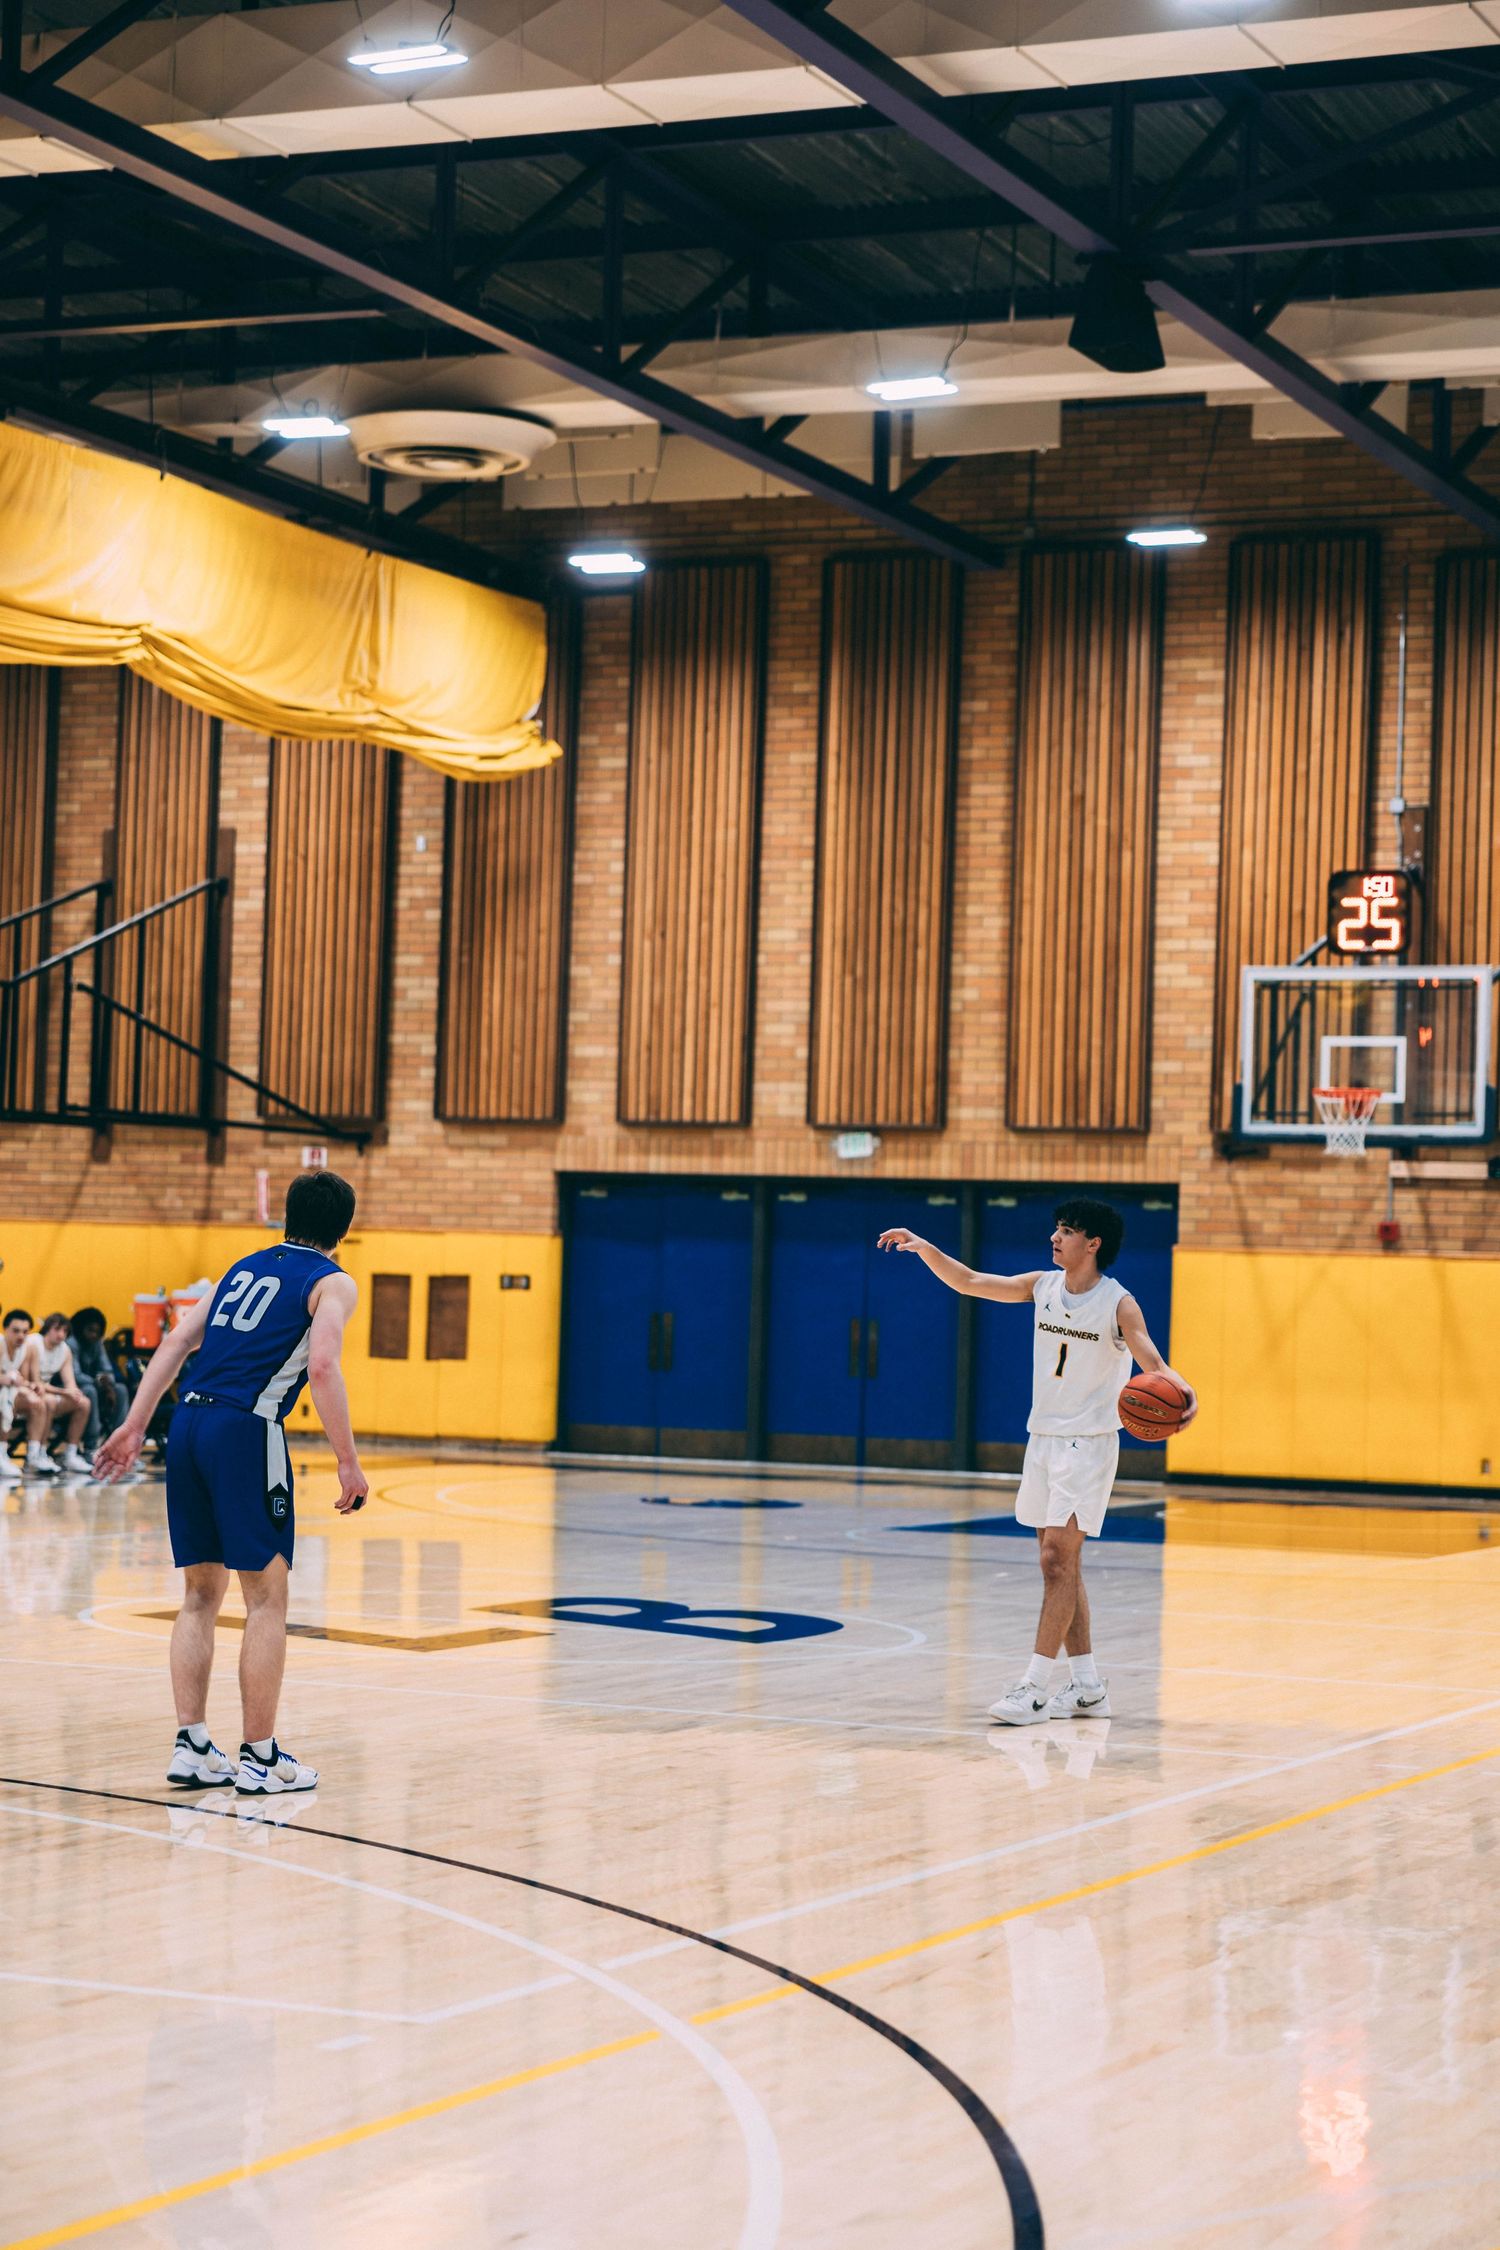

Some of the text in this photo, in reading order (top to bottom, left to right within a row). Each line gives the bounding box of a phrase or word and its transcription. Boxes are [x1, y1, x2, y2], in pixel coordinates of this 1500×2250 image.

[1338, 897, 1400, 950] 25
[211, 1271, 281, 1332] 20
[1038, 1322, 1100, 1342] ROADRUNNERS
[1055, 1342, 1068, 1378] 1
